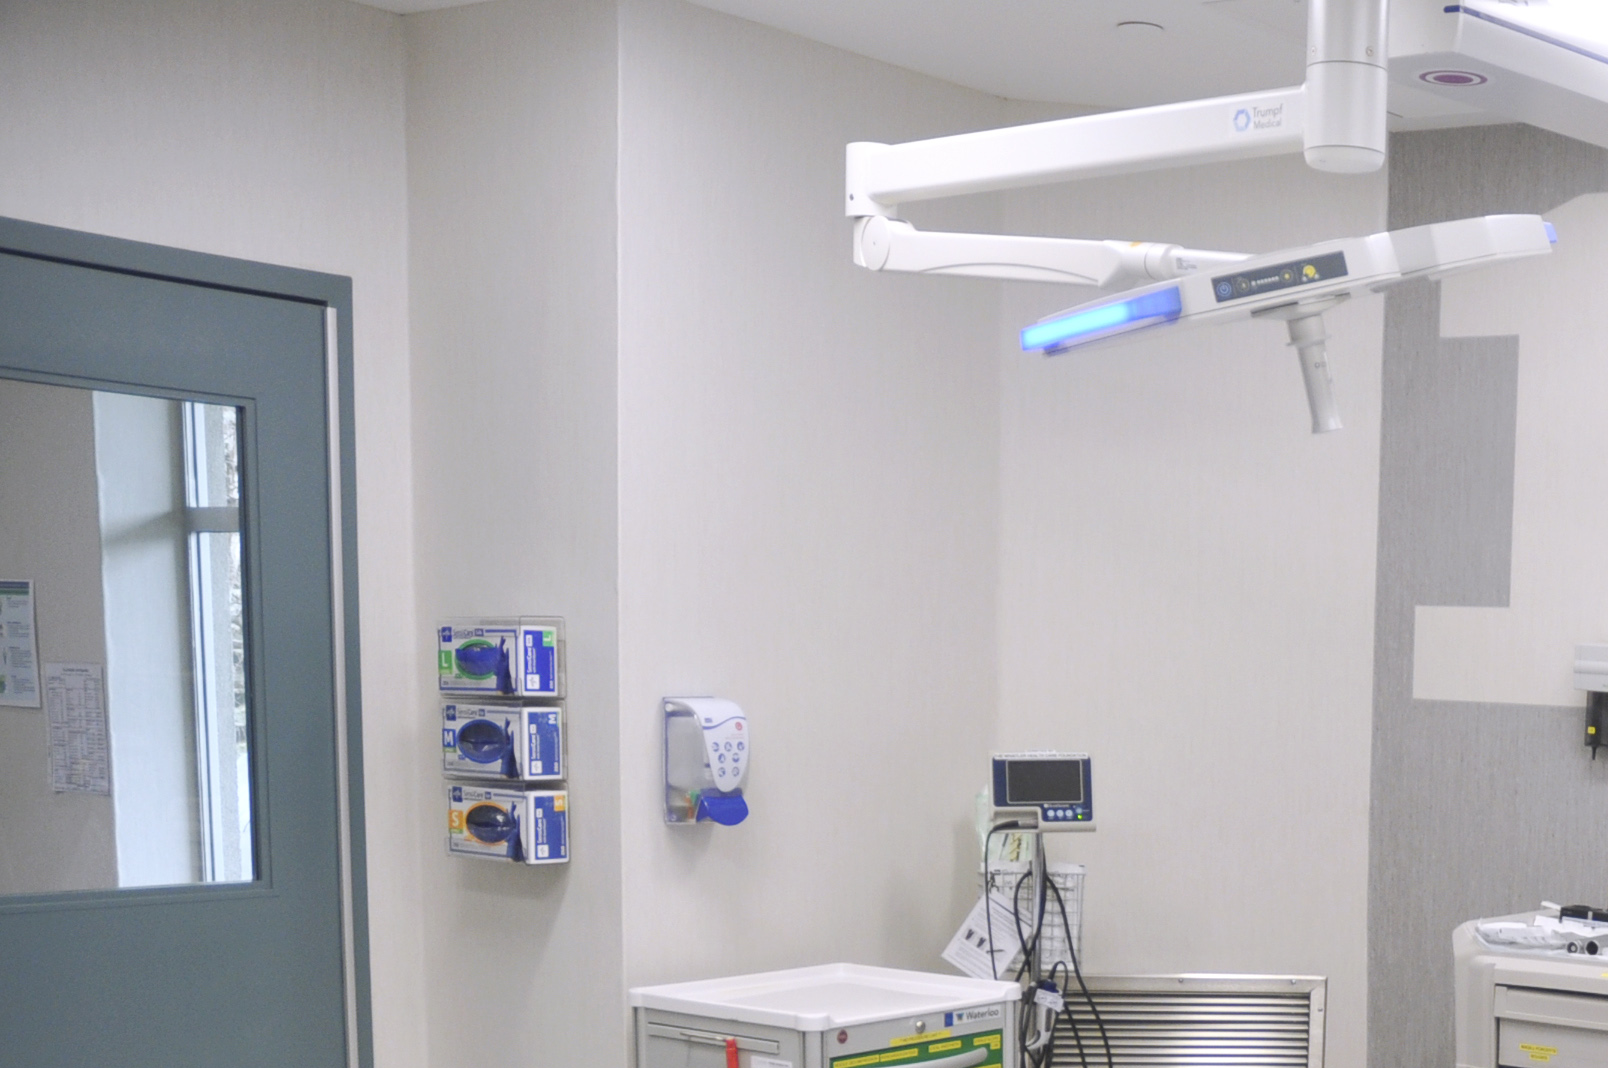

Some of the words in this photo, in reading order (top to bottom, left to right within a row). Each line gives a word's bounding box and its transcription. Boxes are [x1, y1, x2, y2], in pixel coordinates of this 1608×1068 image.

[1252, 103, 1284, 118] Trumpf
[1253, 117, 1282, 129] Medical
[442, 652, 448, 667] L
[548, 713, 557, 725] M
[444, 730, 454, 746] M
[451, 811, 459, 827] S
[966, 1009, 999, 1020] Waterloo
